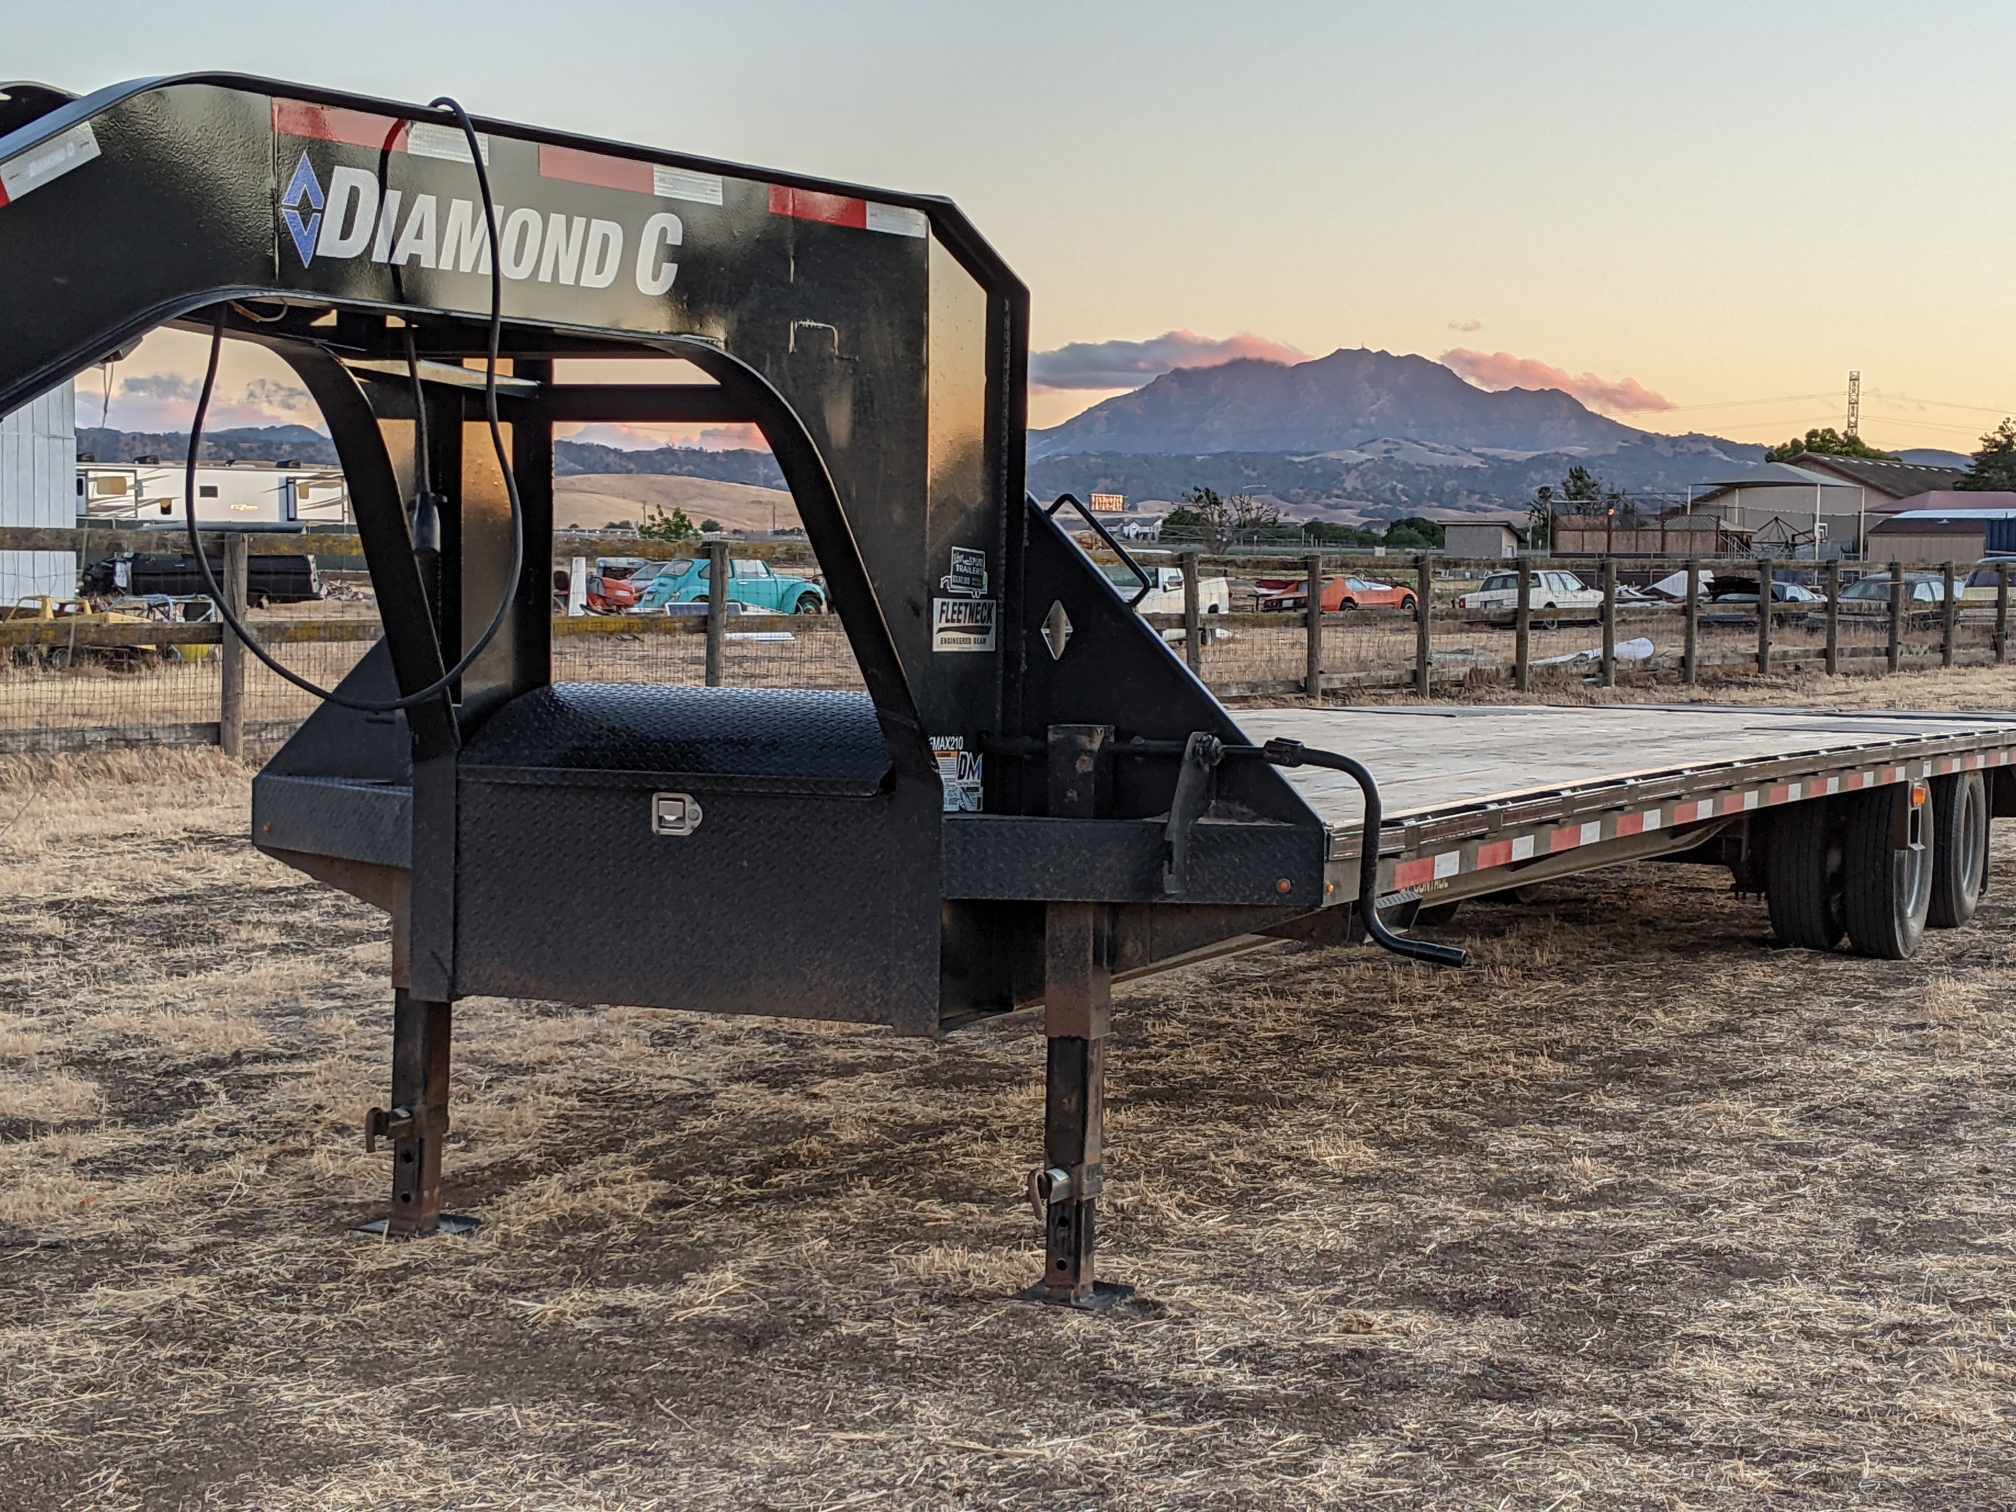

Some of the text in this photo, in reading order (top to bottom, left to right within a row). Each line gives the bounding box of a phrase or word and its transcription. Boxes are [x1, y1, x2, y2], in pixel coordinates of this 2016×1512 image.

[315, 165, 684, 297] DIAMOND C
[939, 601, 994, 624] FLEETNECK
